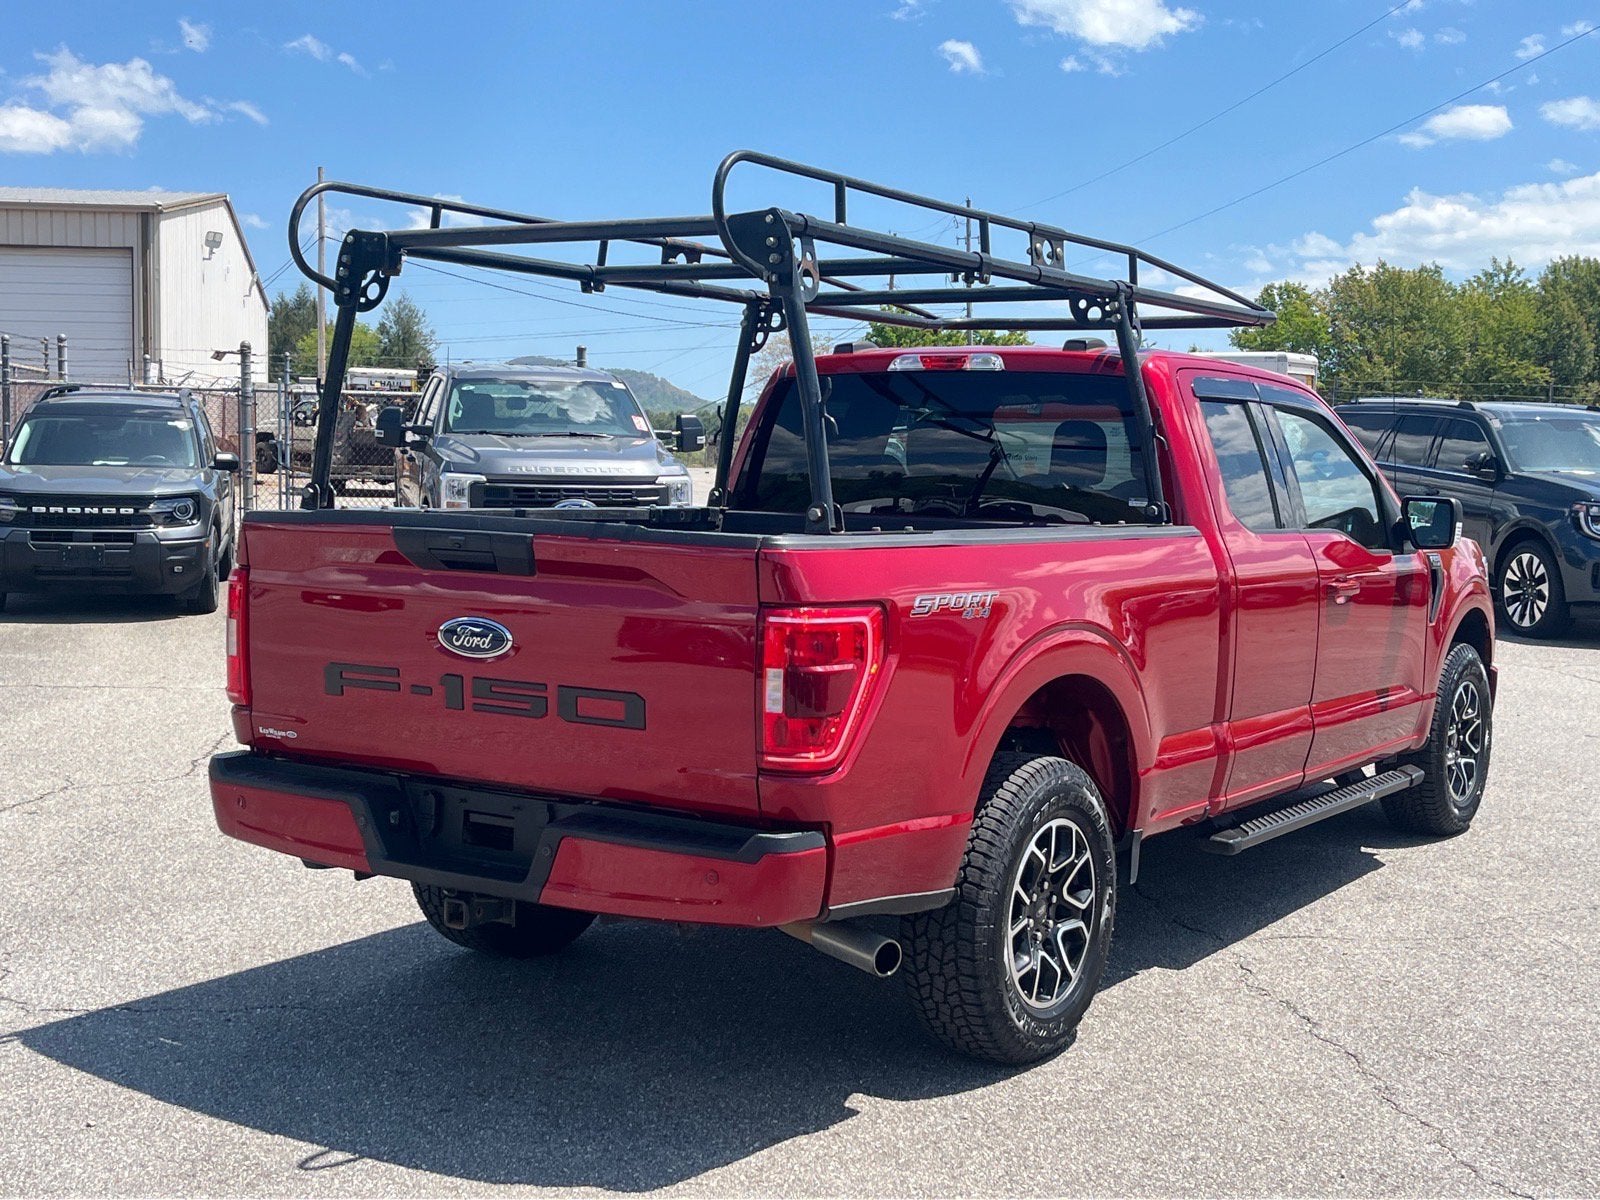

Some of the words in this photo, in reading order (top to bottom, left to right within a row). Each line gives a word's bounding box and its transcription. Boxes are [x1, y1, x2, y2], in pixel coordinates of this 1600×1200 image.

[507, 465, 580, 474] SUPER
[584, 466, 636, 475] DUTY
[32, 506, 134, 514] BRONCO
[911, 591, 999, 616] SPORT
[452, 624, 494, 649] Ford
[324, 662, 646, 730] F-150
